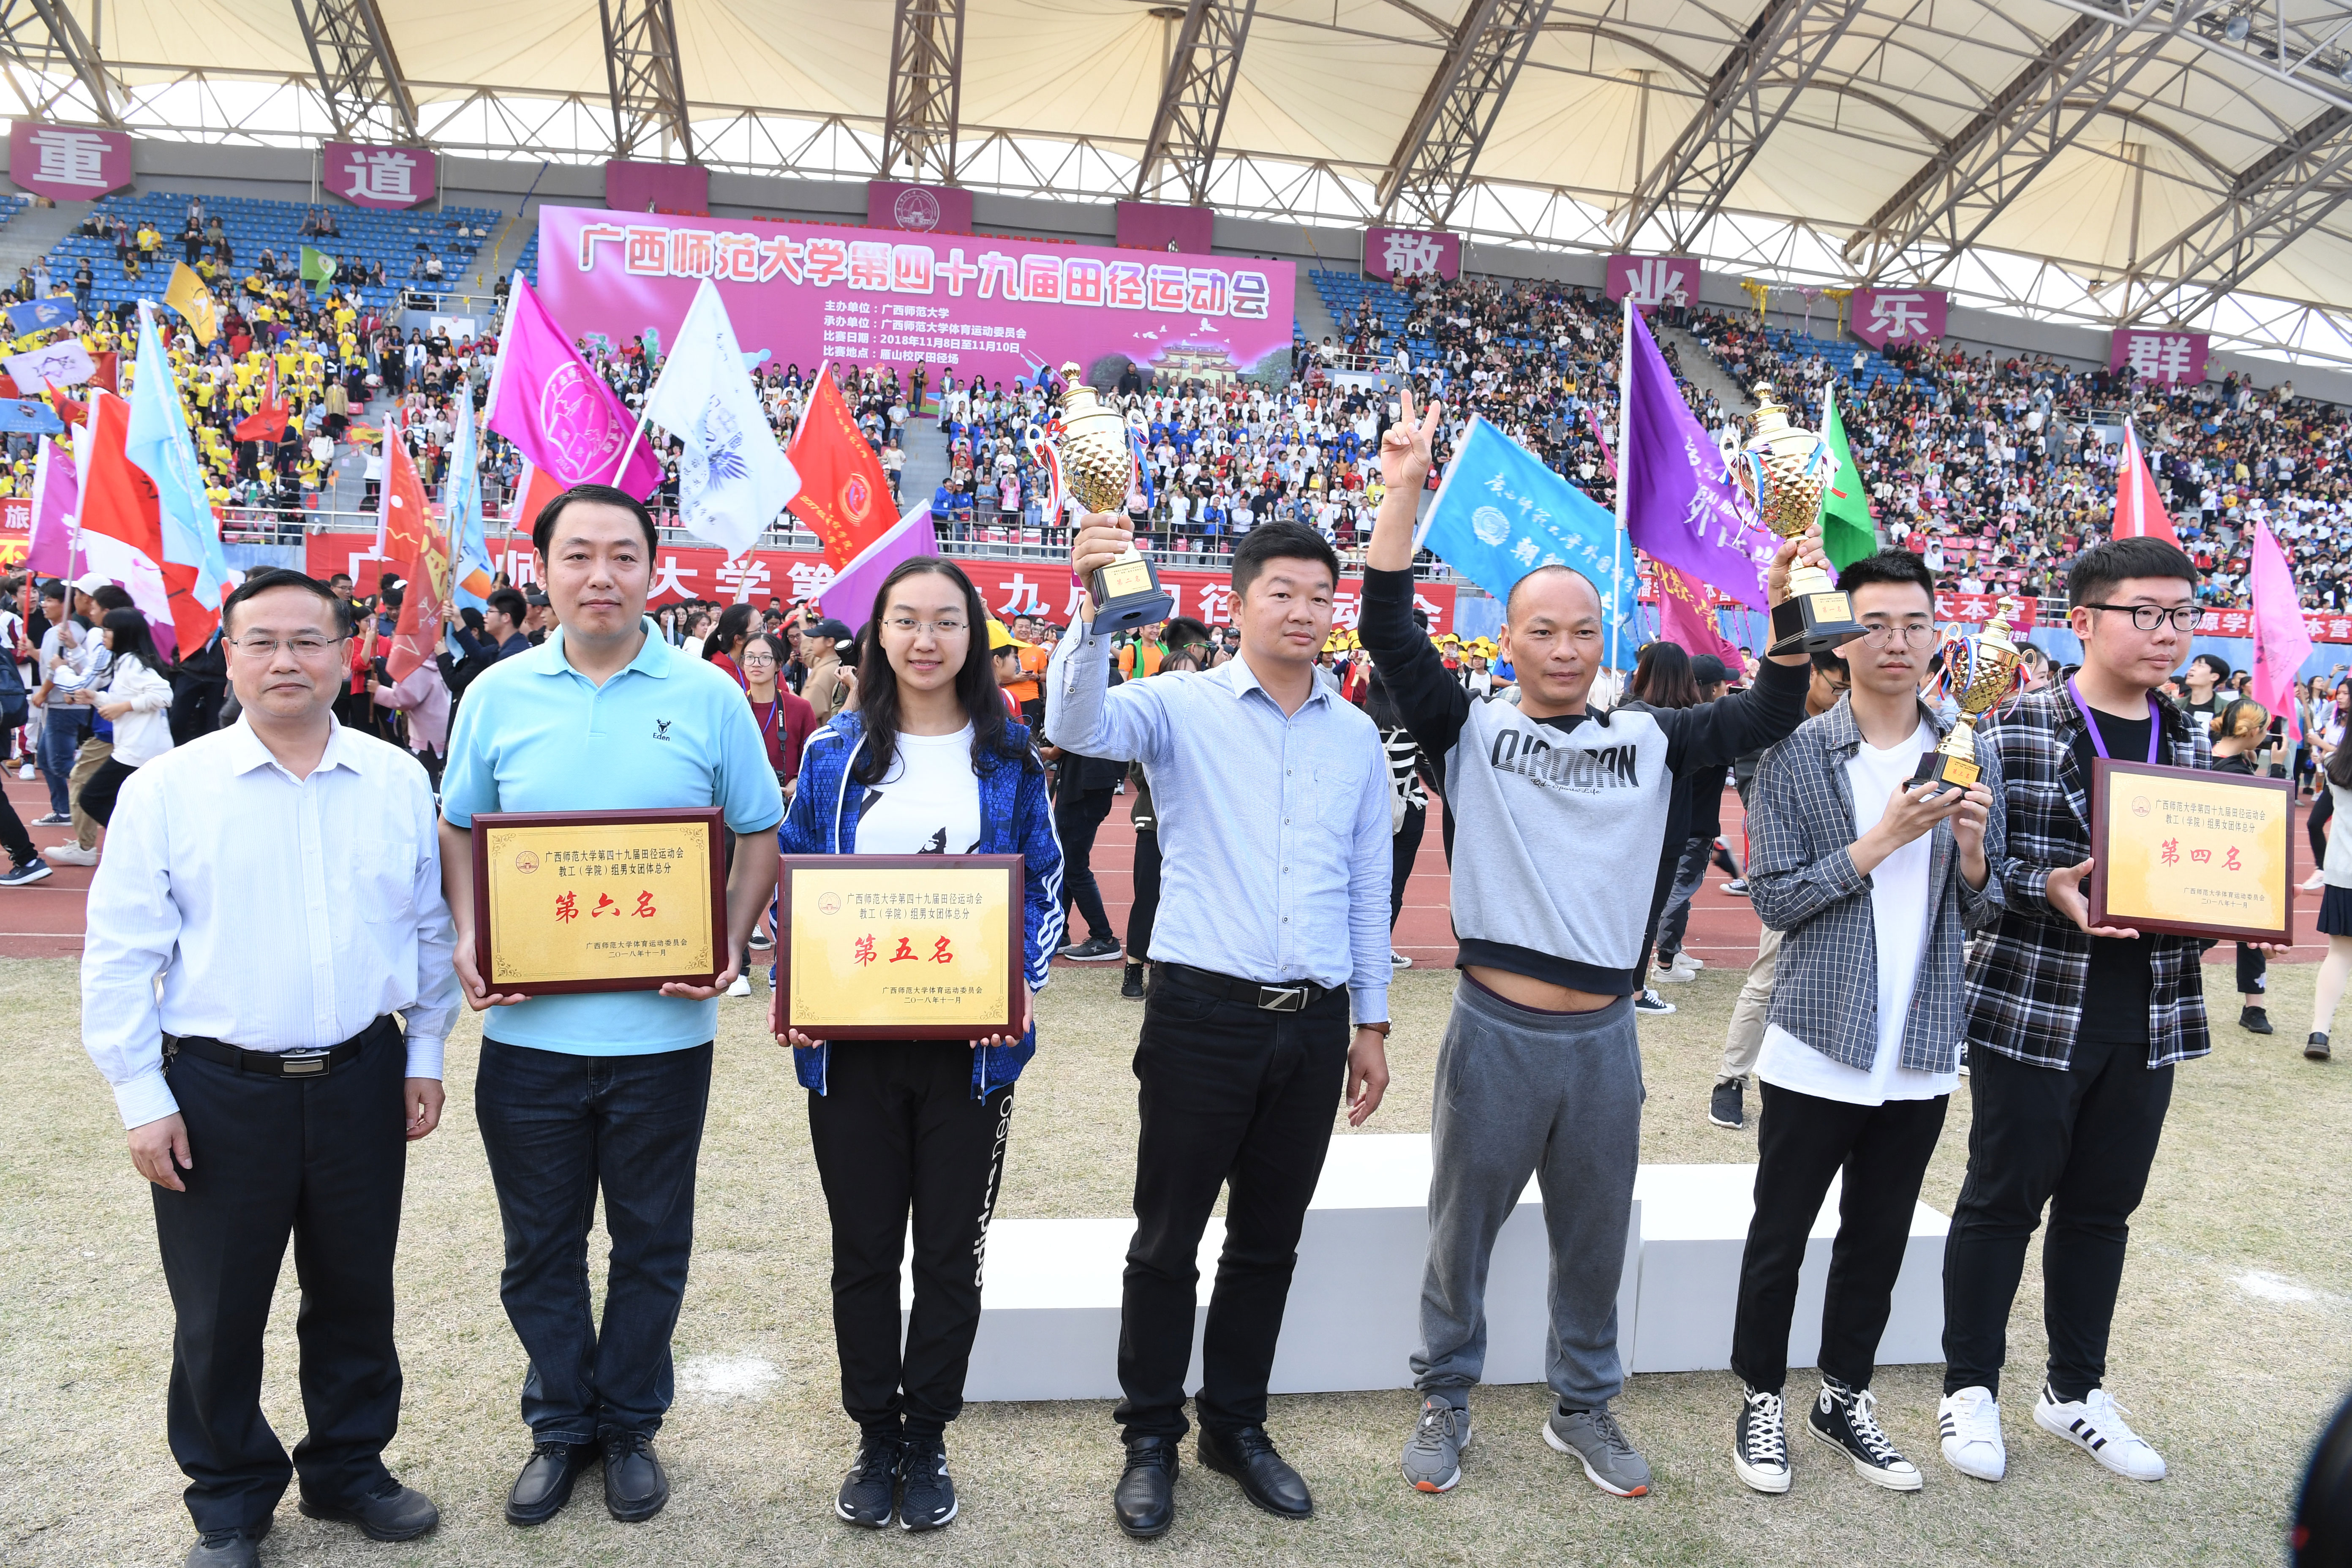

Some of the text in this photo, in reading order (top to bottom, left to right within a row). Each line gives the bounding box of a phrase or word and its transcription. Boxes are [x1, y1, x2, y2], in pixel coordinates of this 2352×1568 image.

[30, 130, 112, 187] 重
[344, 150, 417, 202] 道
[1383, 232, 1443, 275] 敬
[578, 223, 1269, 319] 广西师范大学第四十九届田径运动会
[1625, 259, 1684, 305] 业
[1865, 294, 1928, 335] 乐
[2127, 335, 2191, 383] 群
[653, 732, 670, 741] Eden
[2155, 798, 2266, 821] 广西师范大学第四十九届田径运动会
[545, 847, 683, 863] 广西师范大学第四十九届田径运动会
[2160, 837, 2242, 871] 第四名
[555, 890, 657, 924] 第六名
[847, 892, 983, 905] 广西师范大学第四十九届田径运动会
[2183, 887, 2265, 901] 广西师范大学体育运动委员会
[585, 939, 688, 950] 广西师范大学体育运动委员会
[853, 933, 954, 967] 第五名
[882, 986, 983, 994] 广西师范大学体育运动委员会
[991, 1094, 1013, 1161] neo
